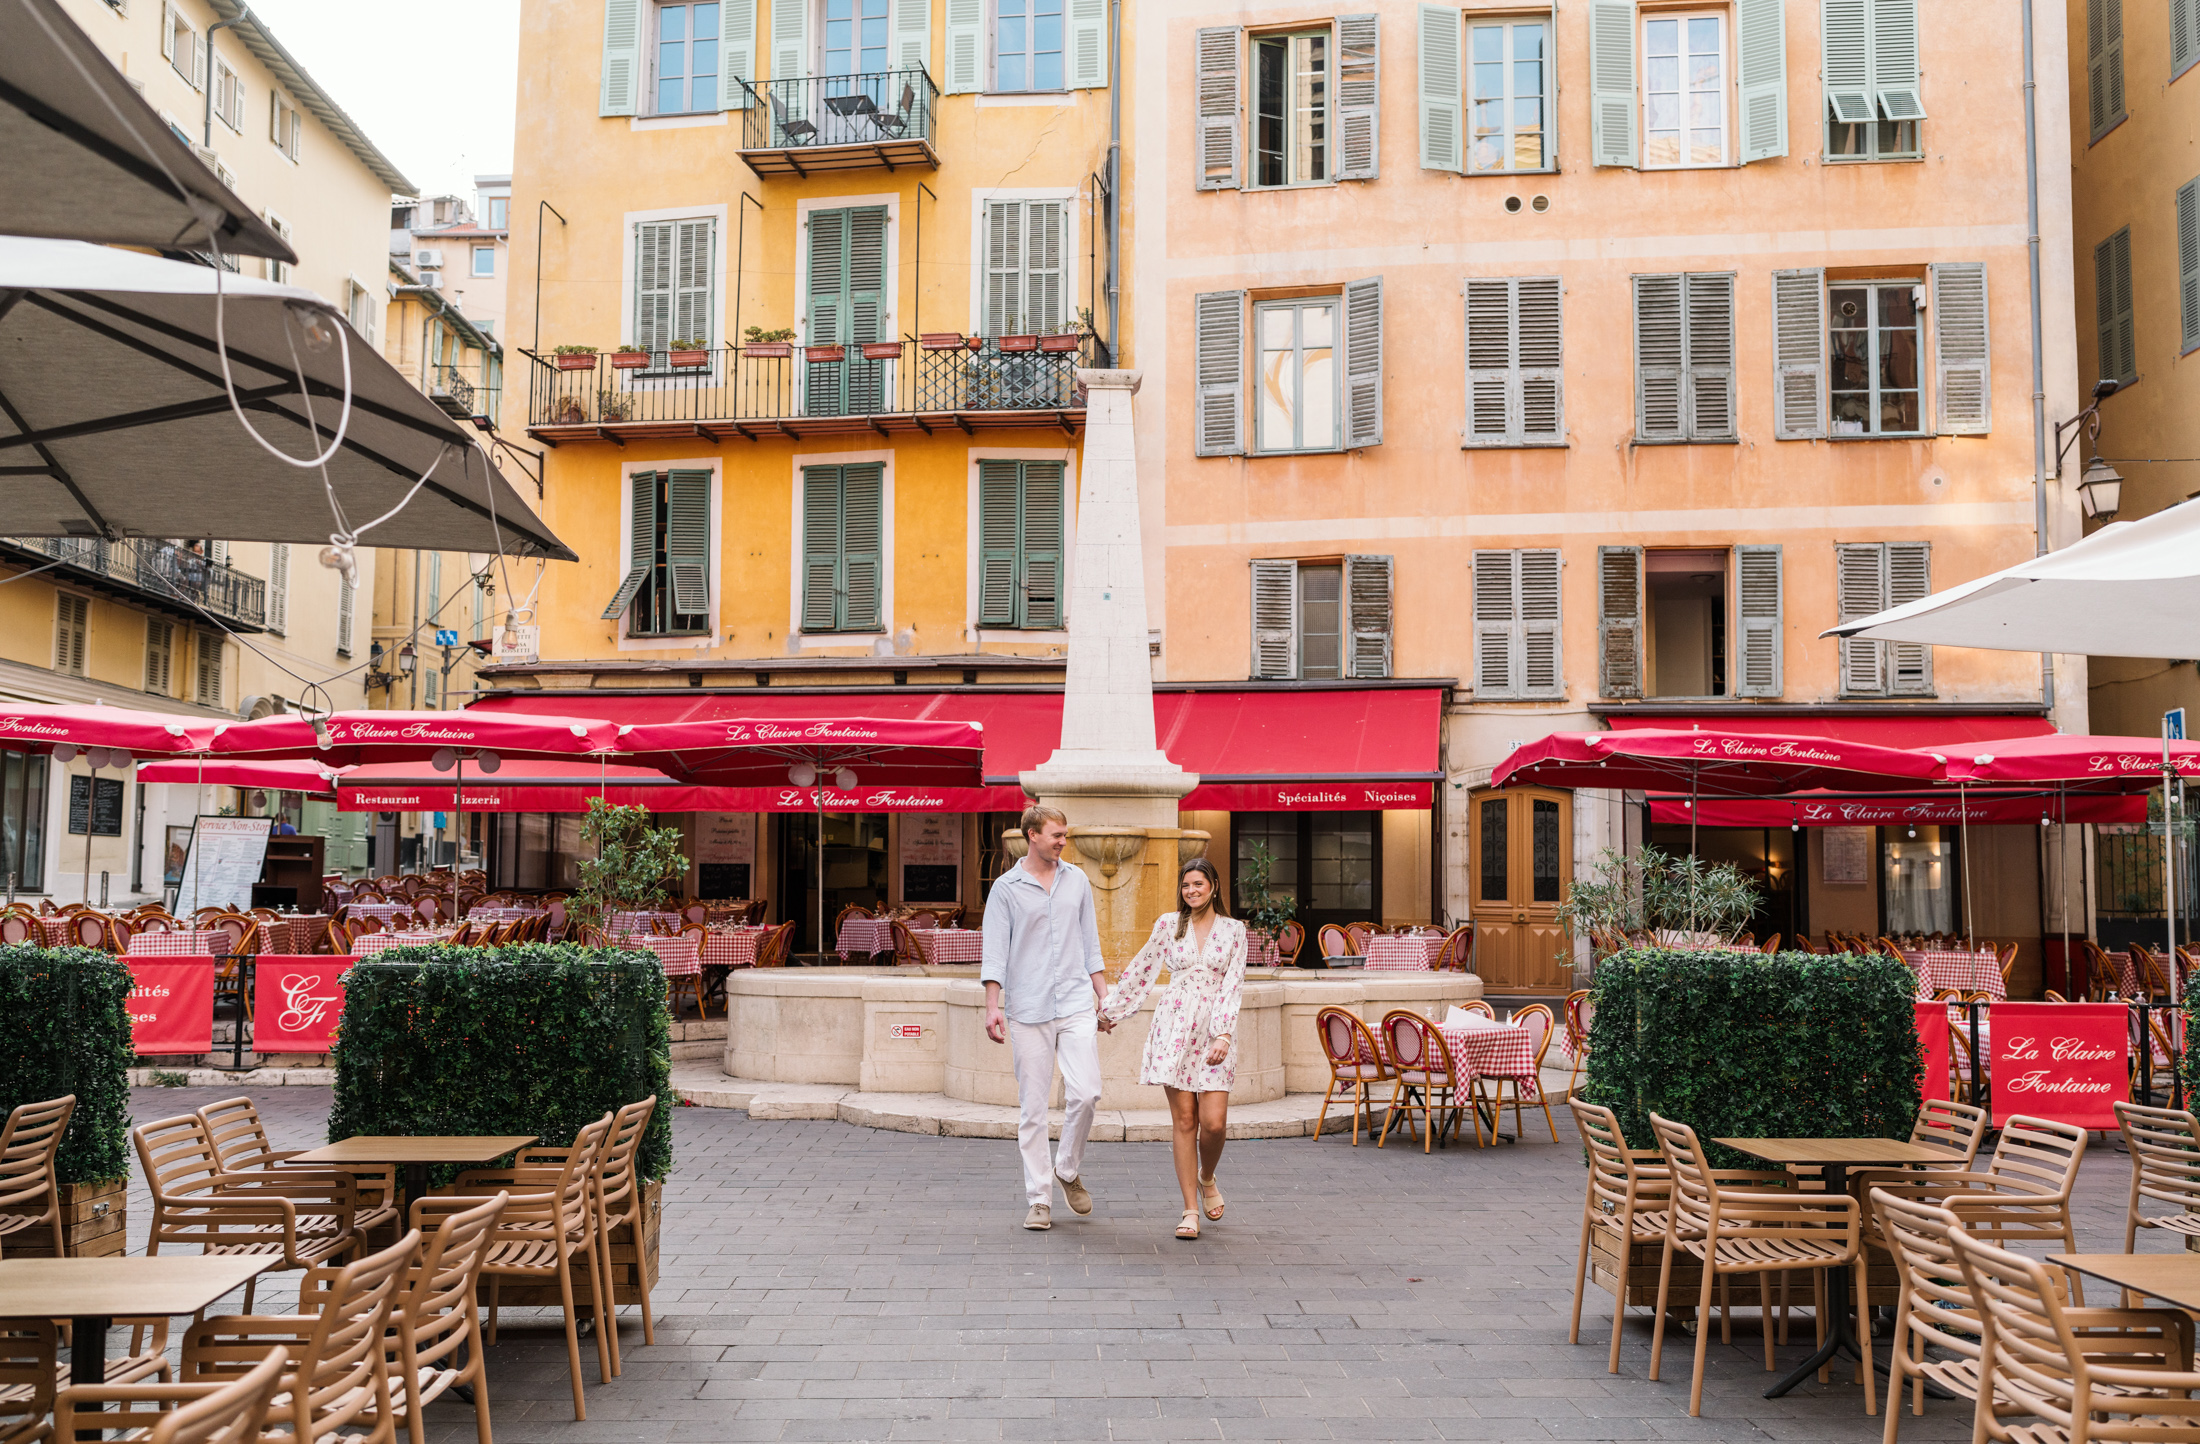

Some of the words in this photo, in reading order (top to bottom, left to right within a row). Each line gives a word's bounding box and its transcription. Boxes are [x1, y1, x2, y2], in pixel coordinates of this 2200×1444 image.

[325, 722, 347, 739] La
[350, 722, 399, 740] Claire
[400, 722, 476, 740] Fontaine
[725, 725, 751, 741] La
[754, 723, 802, 740] Claire
[804, 722, 878, 739] Fontaine
[1693, 738, 1717, 755] La
[1720, 738, 1768, 756] Claire
[1769, 741, 1841, 762] Fontaine
[2087, 755, 2114, 772] La
[2117, 754, 2158, 772] Clair
[355, 793, 421, 805] Restaurant
[776, 790, 804, 807] La
[809, 790, 860, 807] Claire
[866, 790, 944, 807] Fontaine
[1277, 791, 1347, 806] Spécialités
[1364, 790, 1417, 804] Niçoises
[1803, 803, 1833, 820] La
[1839, 802, 1896, 821] Claire
[199, 820, 227, 830] Service
[228, 820, 271, 835] Non-Stop
[2001, 1036, 2039, 1060] La
[2050, 1036, 2116, 1062] Claire
[2007, 1069, 2111, 1093] Fontaine
